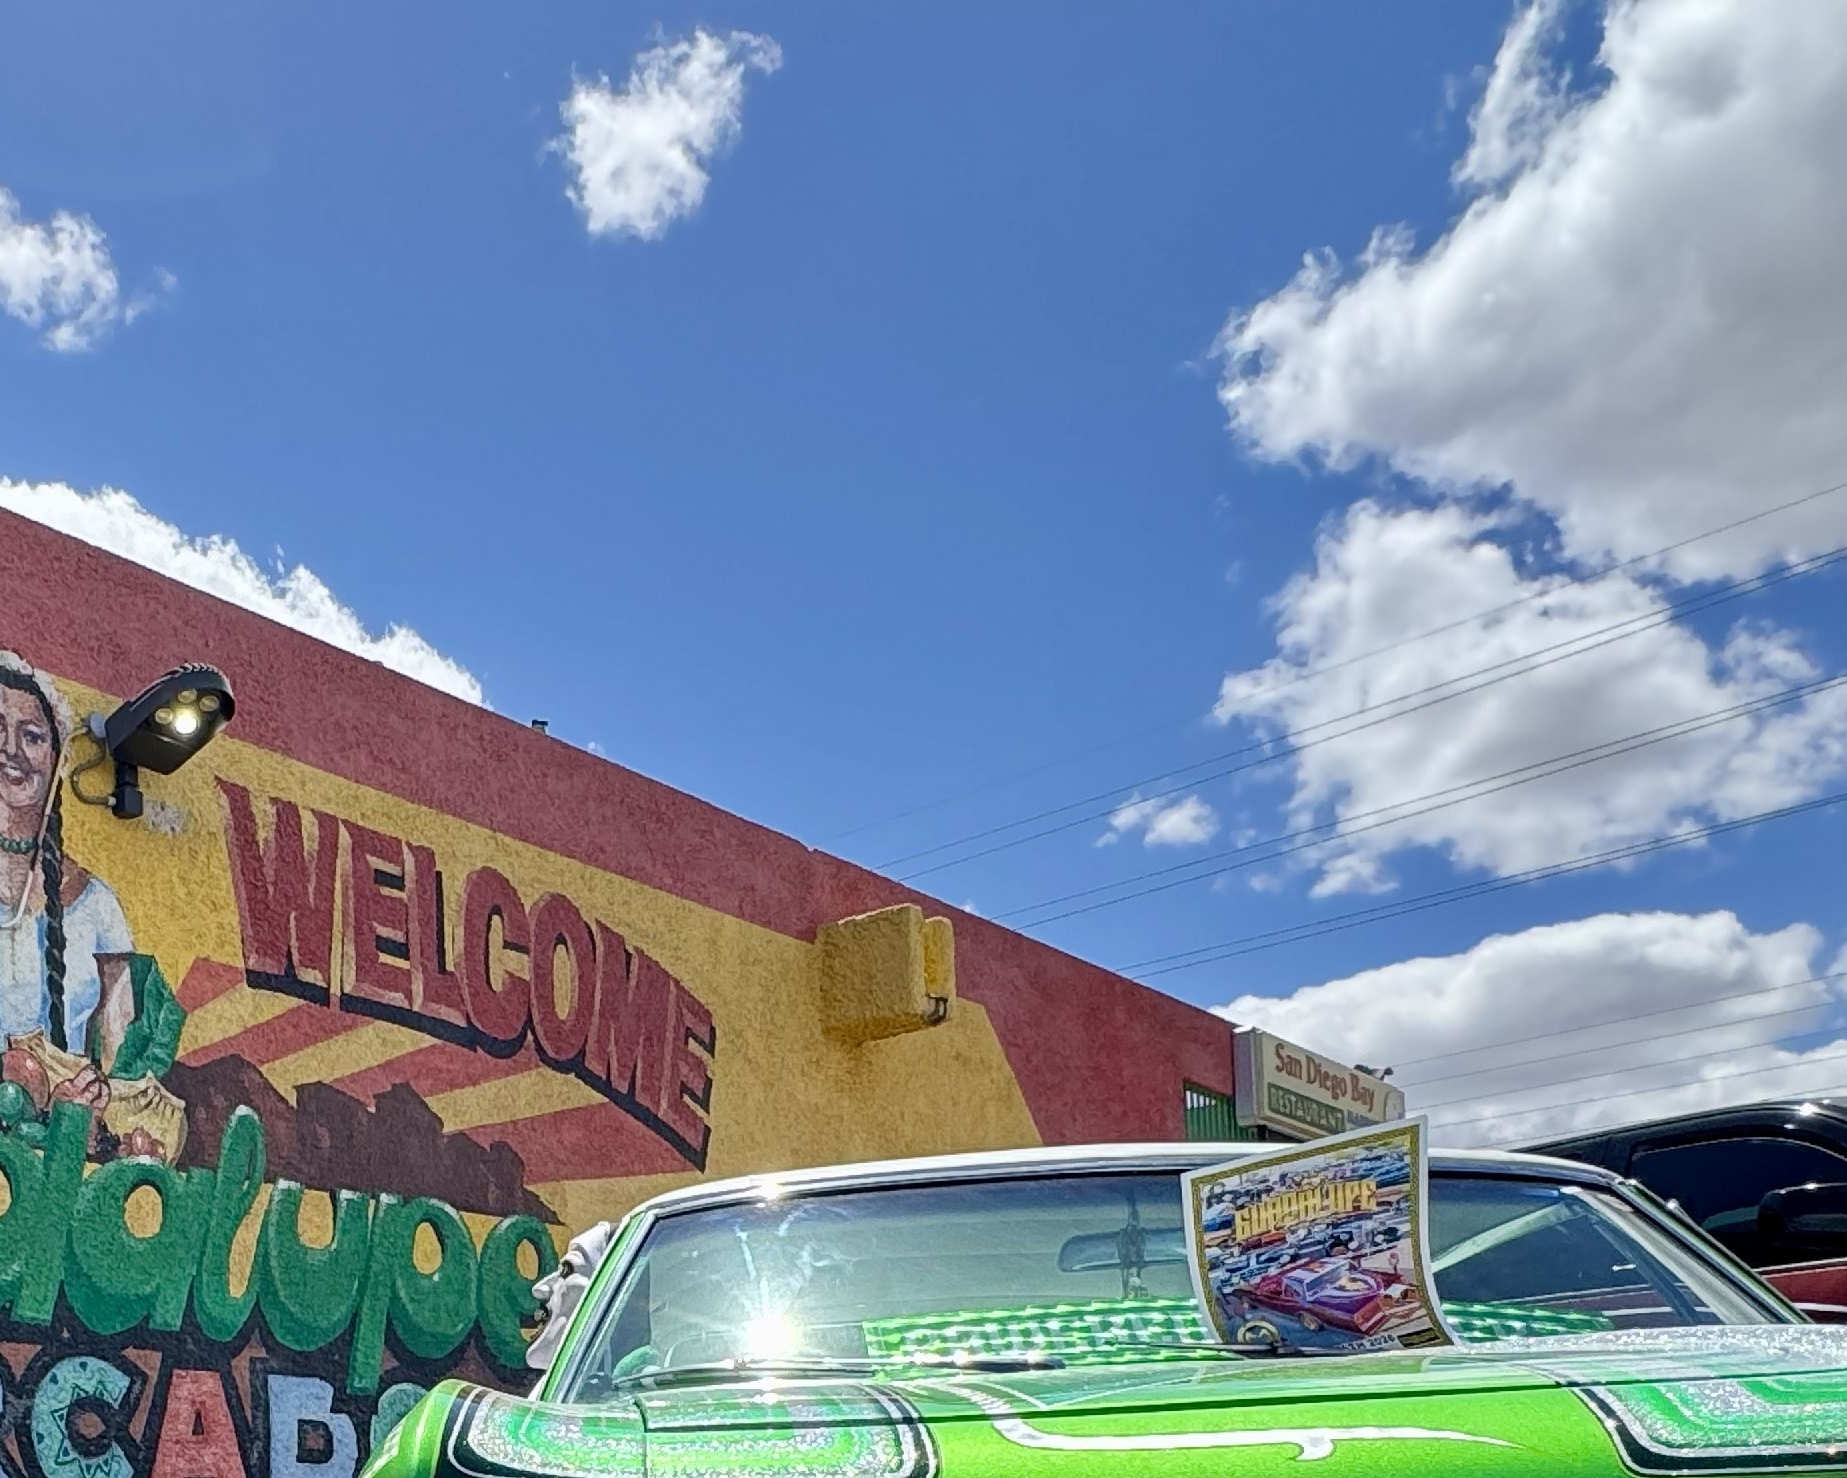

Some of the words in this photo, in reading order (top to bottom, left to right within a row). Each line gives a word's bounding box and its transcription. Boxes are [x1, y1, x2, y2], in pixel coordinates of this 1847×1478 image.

[215, 775, 714, 1172] WELCOME
[1270, 1087, 1343, 1131] RESTAURANT
[1274, 1042, 1303, 1080] San
[1306, 1054, 1348, 1100] Diego
[1349, 1072, 1375, 1112] Bay
